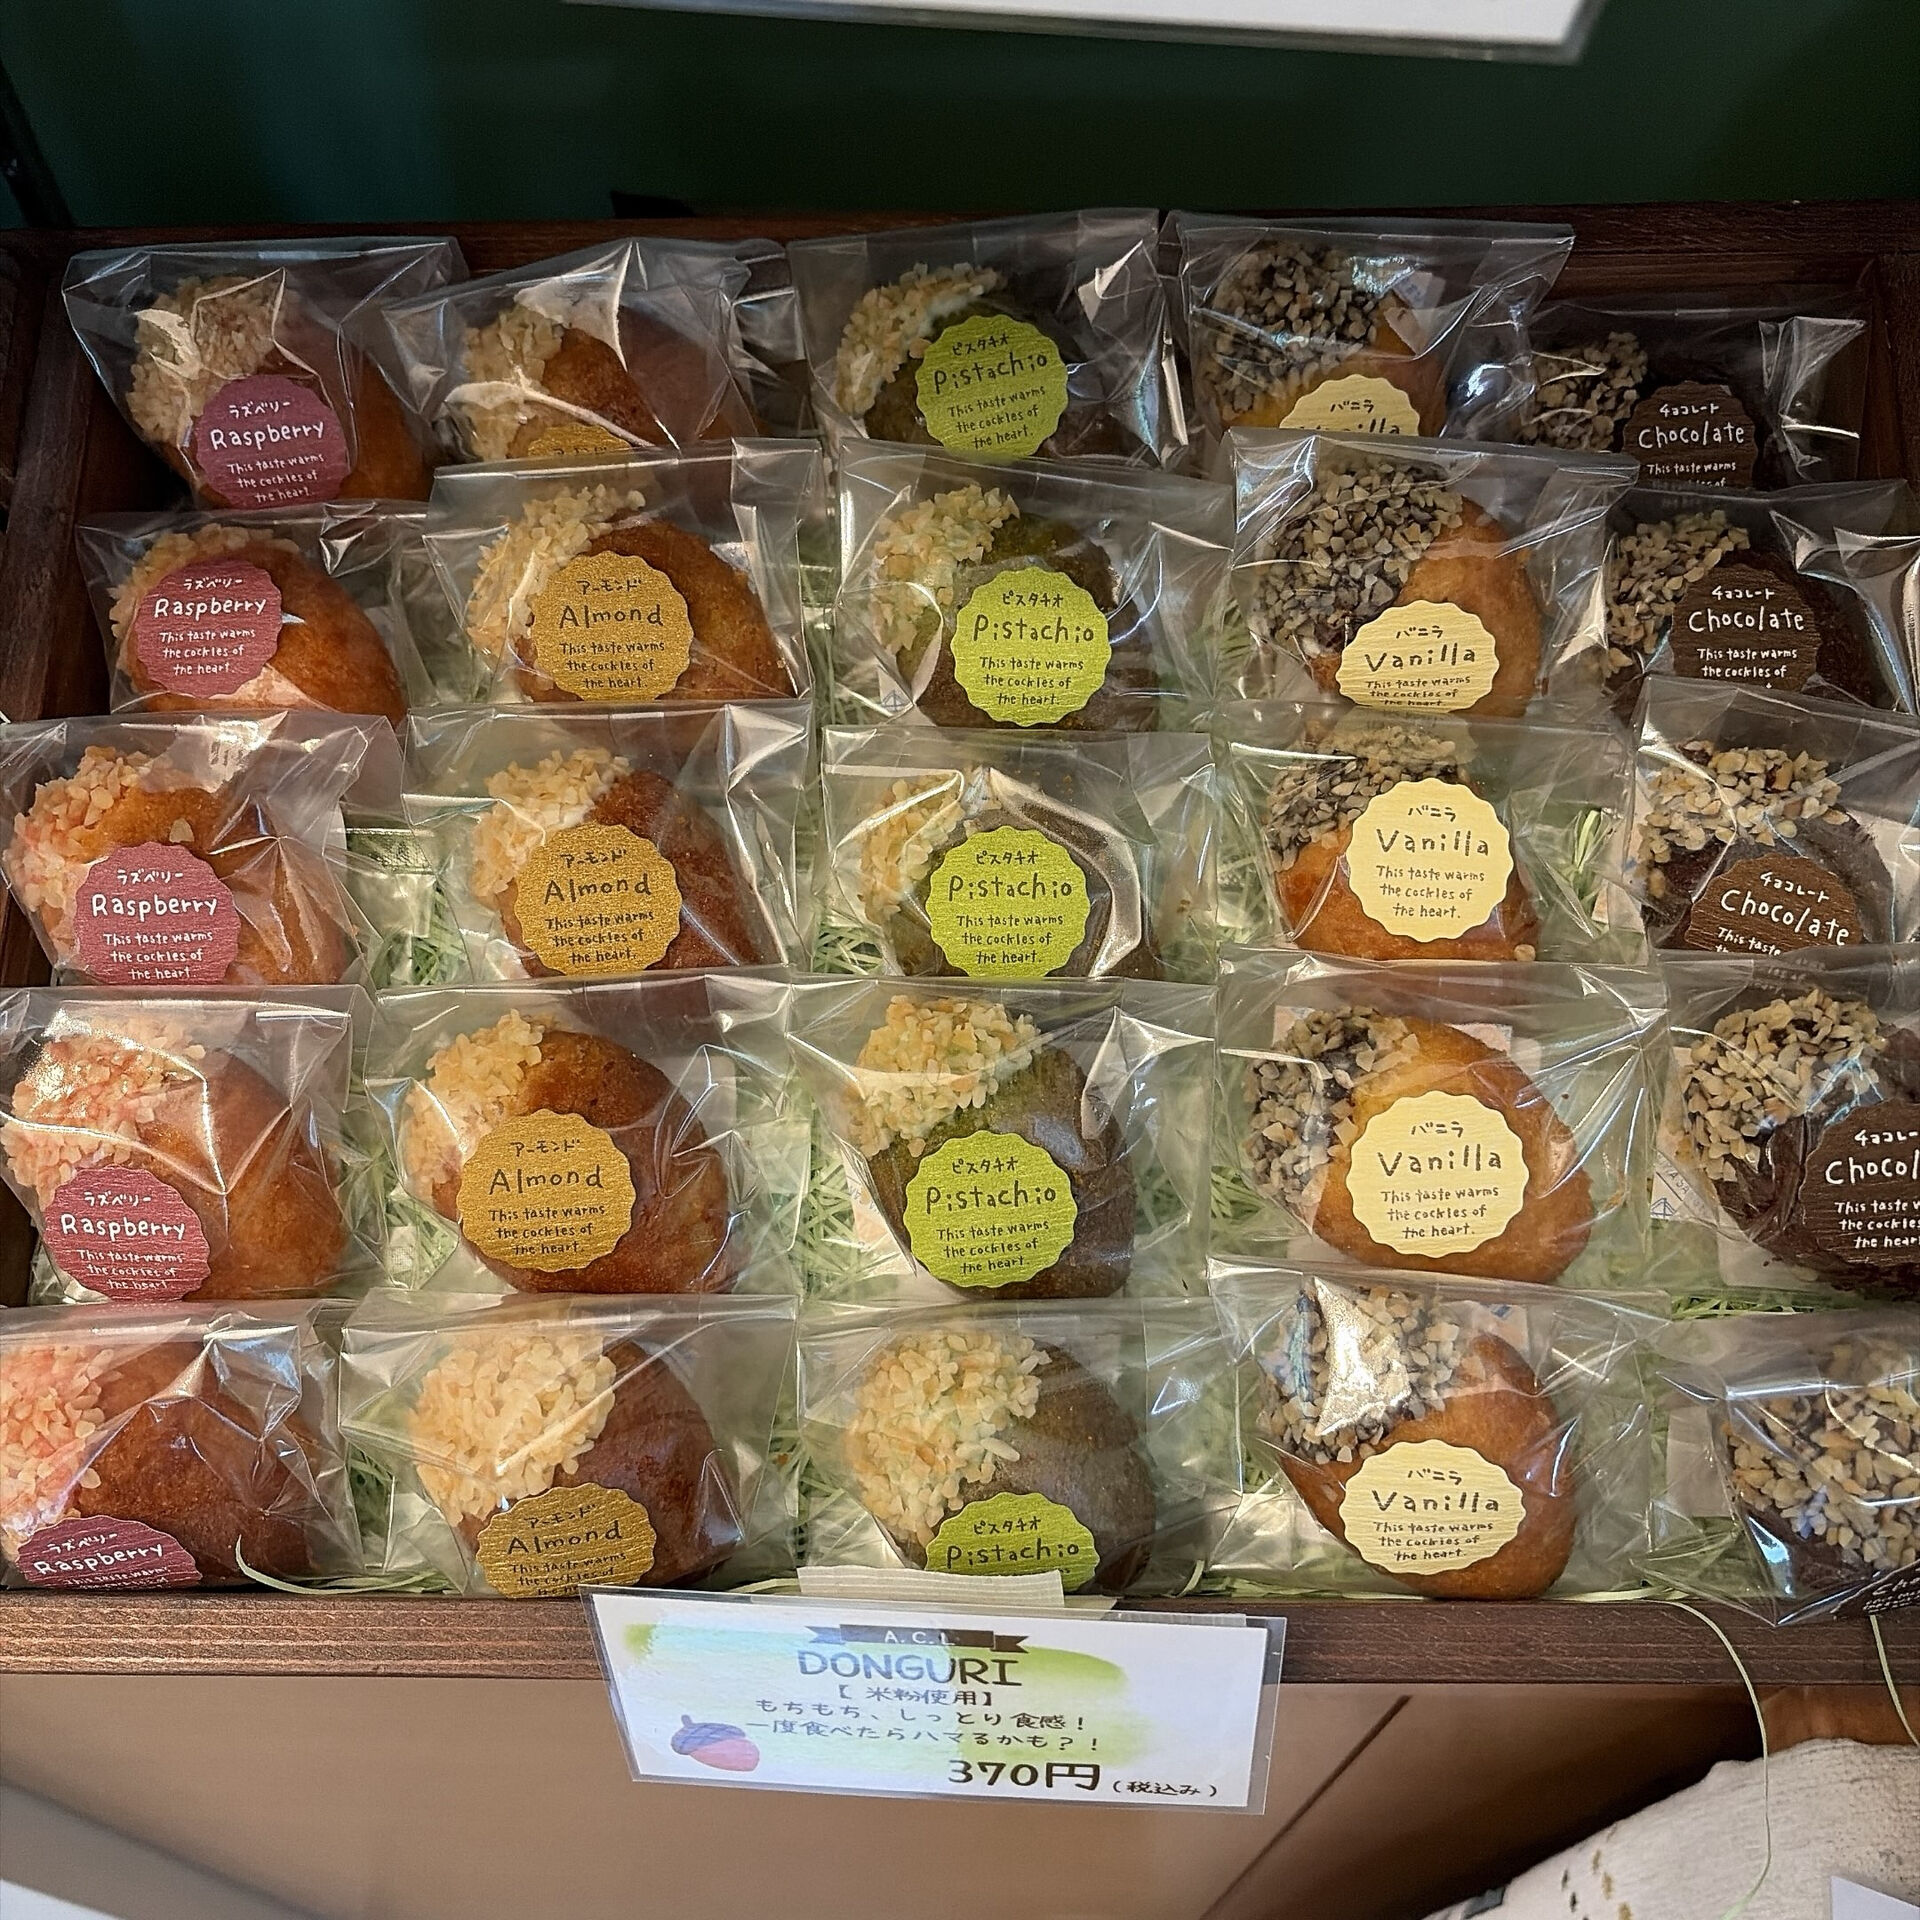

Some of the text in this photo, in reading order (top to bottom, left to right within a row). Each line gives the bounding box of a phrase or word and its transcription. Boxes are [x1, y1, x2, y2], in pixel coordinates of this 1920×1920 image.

[952, 333, 1009, 356] ピスタチオ
[933, 351, 1047, 394] Pistachio
[229, 400, 291, 418] ラズベリー
[948, 386, 1045, 417] This taste warms
[1330, 399, 1374, 414] バニラ
[955, 404, 1039, 433] the cockles of
[210, 421, 324, 450] Raspberry
[1638, 420, 1744, 449] Chocolate
[227, 454, 324, 474] This taste warms
[1646, 461, 1736, 475] This taste warms
[184, 577, 243, 590] ラズベリー
[1002, 589, 1063, 607] ピスタチオ
[154, 597, 267, 621] Raspberry
[559, 604, 664, 629] Almond
[1688, 605, 1804, 632] Chocolate
[159, 629, 256, 643] This taste warms
[973, 614, 1094, 643] Pistachio
[1395, 625, 1443, 639] バニラ
[163, 644, 244, 659] the cockles of
[560, 641, 665, 655] This taste warms
[1364, 642, 1475, 672] Vanilla
[1696, 647, 1797, 661] This taste warms
[567, 659, 655, 671] the cockles of
[979, 656, 1084, 670] This taste warms
[1701, 664, 1787, 678] the cockles of
[983, 674, 1071, 689] the cockles of
[996, 692, 1016, 705] the
[1408, 805, 1456, 822] バニラ
[1376, 828, 1488, 857] Vanilla
[976, 850, 1039, 865] ピスタチオ
[118, 868, 184, 885] ラズベリー
[1376, 864, 1485, 881] This taste warms
[544, 872, 652, 904] Almond
[948, 872, 1072, 901] Pistachio
[1379, 882, 1473, 901] the cockles of
[92, 893, 218, 923] Raspberry
[1392, 902, 1414, 917] the
[545, 911, 654, 931] This taste warms
[956, 915, 1064, 928] This taste warms
[1720, 889, 1850, 946] Chocolate
[103, 931, 214, 946] This taste warms
[552, 928, 645, 947] the cockles of
[962, 932, 1052, 945] the cockles of
[1717, 926, 1744, 944] This
[111, 948, 205, 963] the cockles of
[976, 951, 996, 964] the
[1410, 1120, 1464, 1138] バニラ
[1854, 1129, 1919, 1147] チョコレー
[952, 1156, 1018, 1174] ピスタチオ
[1377, 1143, 1502, 1176] Vanilla
[489, 1164, 604, 1195] Almond
[84, 1190, 152, 1207] ラズベリー
[926, 1179, 1056, 1214] Pistachio
[1380, 1186, 1499, 1204] This taste warms
[489, 1204, 605, 1222] This taste warms
[1387, 1204, 1487, 1221] the cockles of
[1834, 1201, 1865, 1215] This
[1870, 1199, 1908, 1213] taste
[61, 1213, 186, 1242] Raspberry
[495, 1222, 593, 1240] the cockles of
[936, 1220, 1049, 1241] This taste warms
[1402, 1226, 1425, 1239] the
[1838, 1219, 1863, 1231] the
[943, 1237, 1038, 1258] the cockles of
[960, 1262, 982, 1275] the
[1407, 1468, 1462, 1485] バニラ
[1371, 1489, 1499, 1513] Vanilla
[973, 1516, 1041, 1535] ピスタチオ
[47, 1533, 118, 1553] ラズベリー
[507, 1519, 622, 1555] Almond
[33, 1543, 163, 1575] Raspberry
[946, 1537, 1080, 1570] Pistachio
[797, 1650, 1023, 1687] DONGURI
[948, 1759, 1100, 1791] 370円
